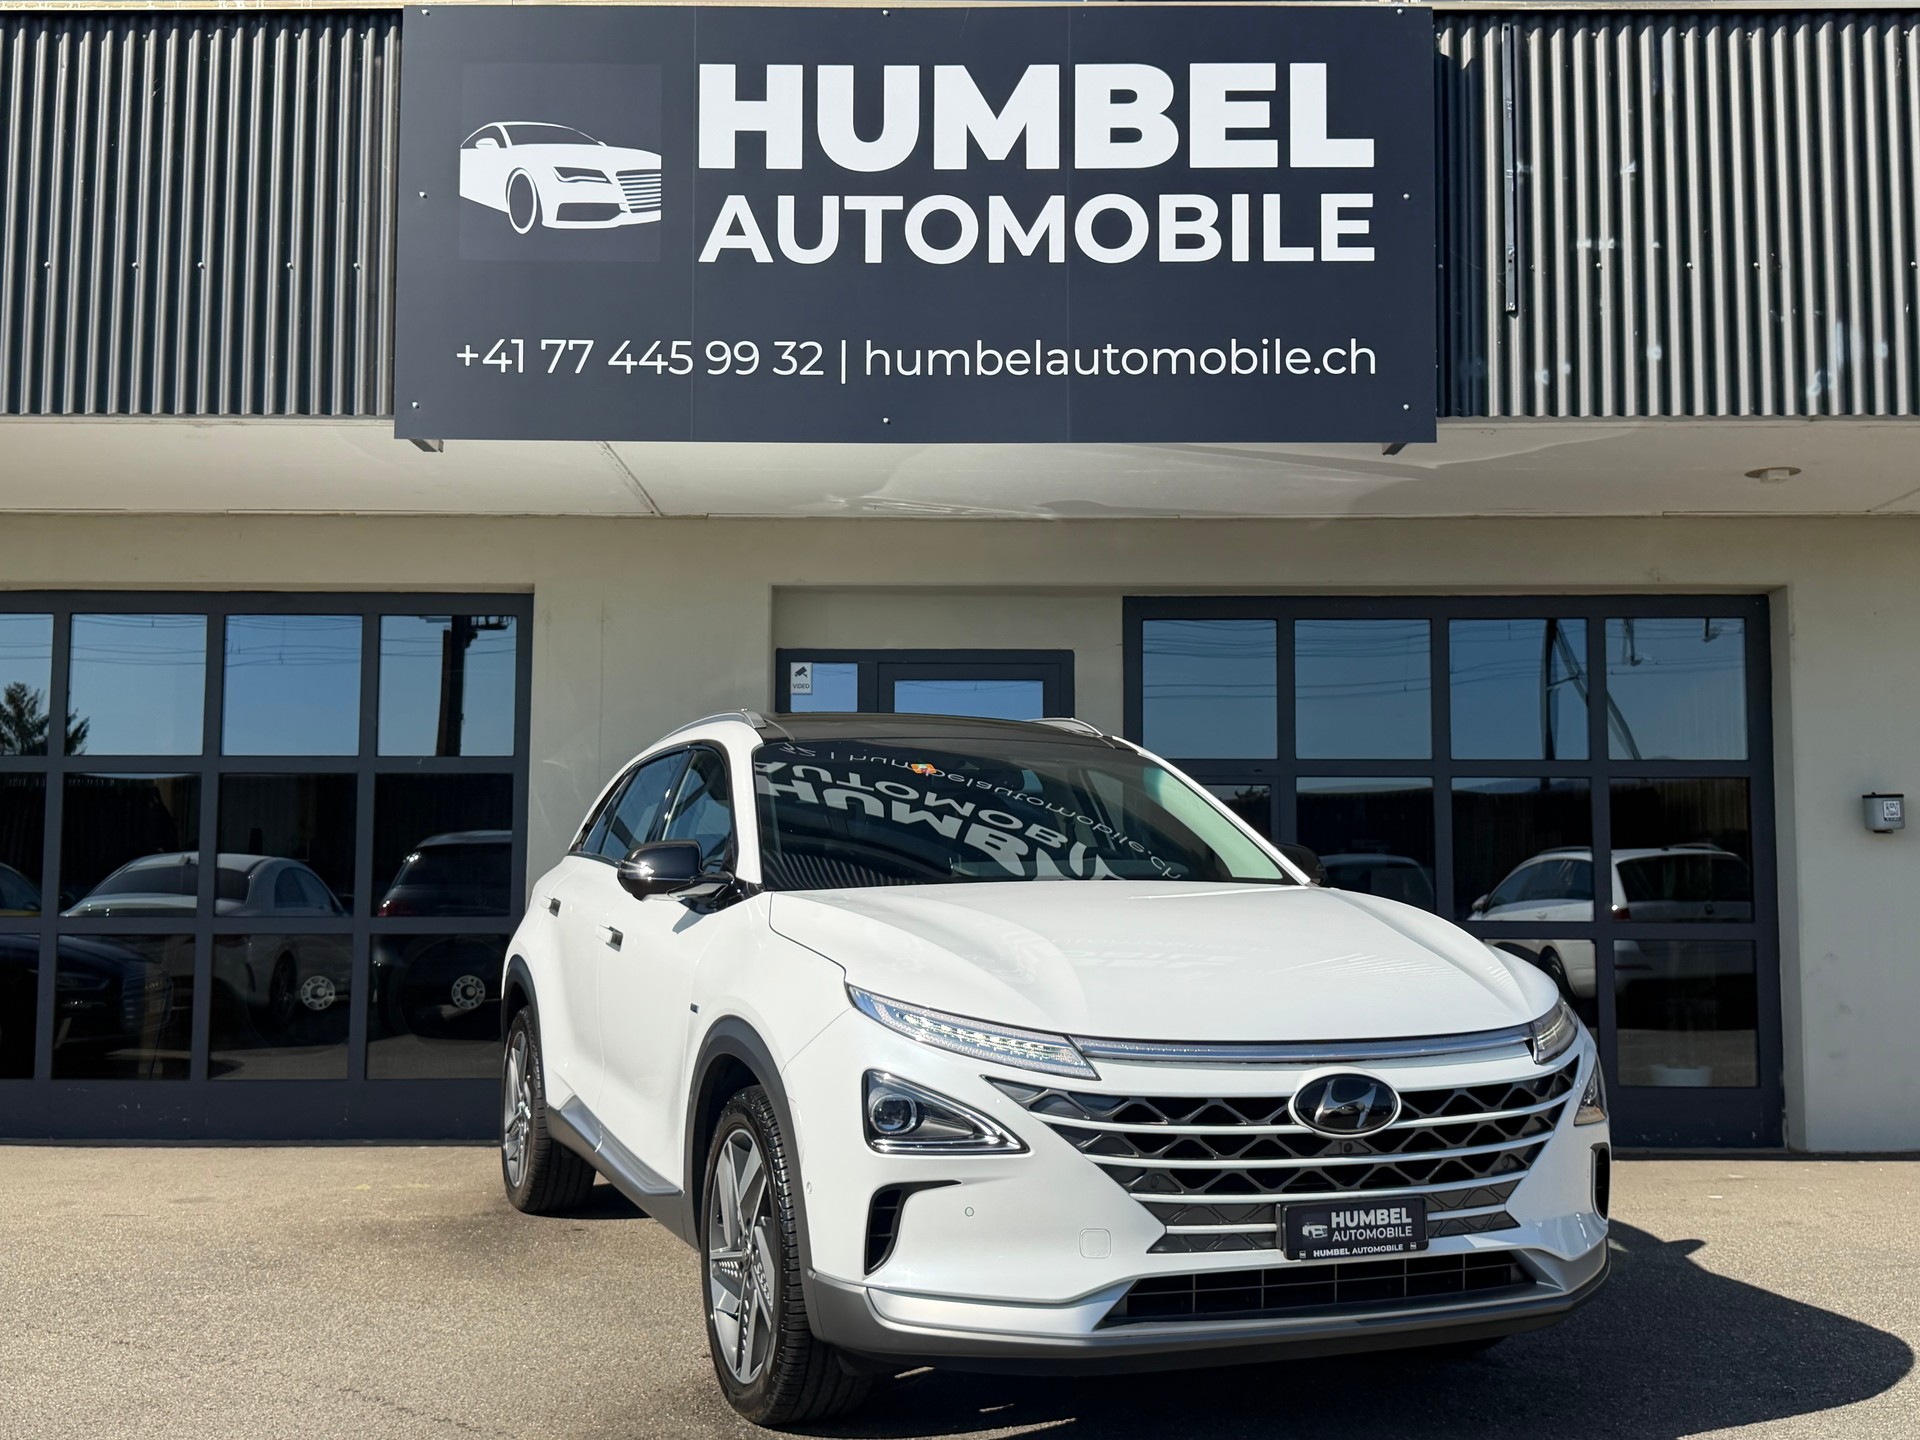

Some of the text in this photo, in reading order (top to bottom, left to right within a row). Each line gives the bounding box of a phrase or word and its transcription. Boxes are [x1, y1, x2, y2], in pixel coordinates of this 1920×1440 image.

[699, 63, 1375, 172] HUMBEL
[699, 193, 1375, 265] AUTOMOBILE
[456, 339, 524, 374] +41
[540, 339, 595, 374] 77
[607, 340, 694, 375] 445
[705, 341, 760, 376] 99
[772, 341, 824, 376] 32
[865, 338, 1376, 376] humbelautomobile.ch
[1331, 1207, 1413, 1229] HUMBEL
[1332, 1225, 1413, 1242] AUTOMOBILE
[1313, 1244, 1404, 1258] HUMBEL AUTOMOBILE
